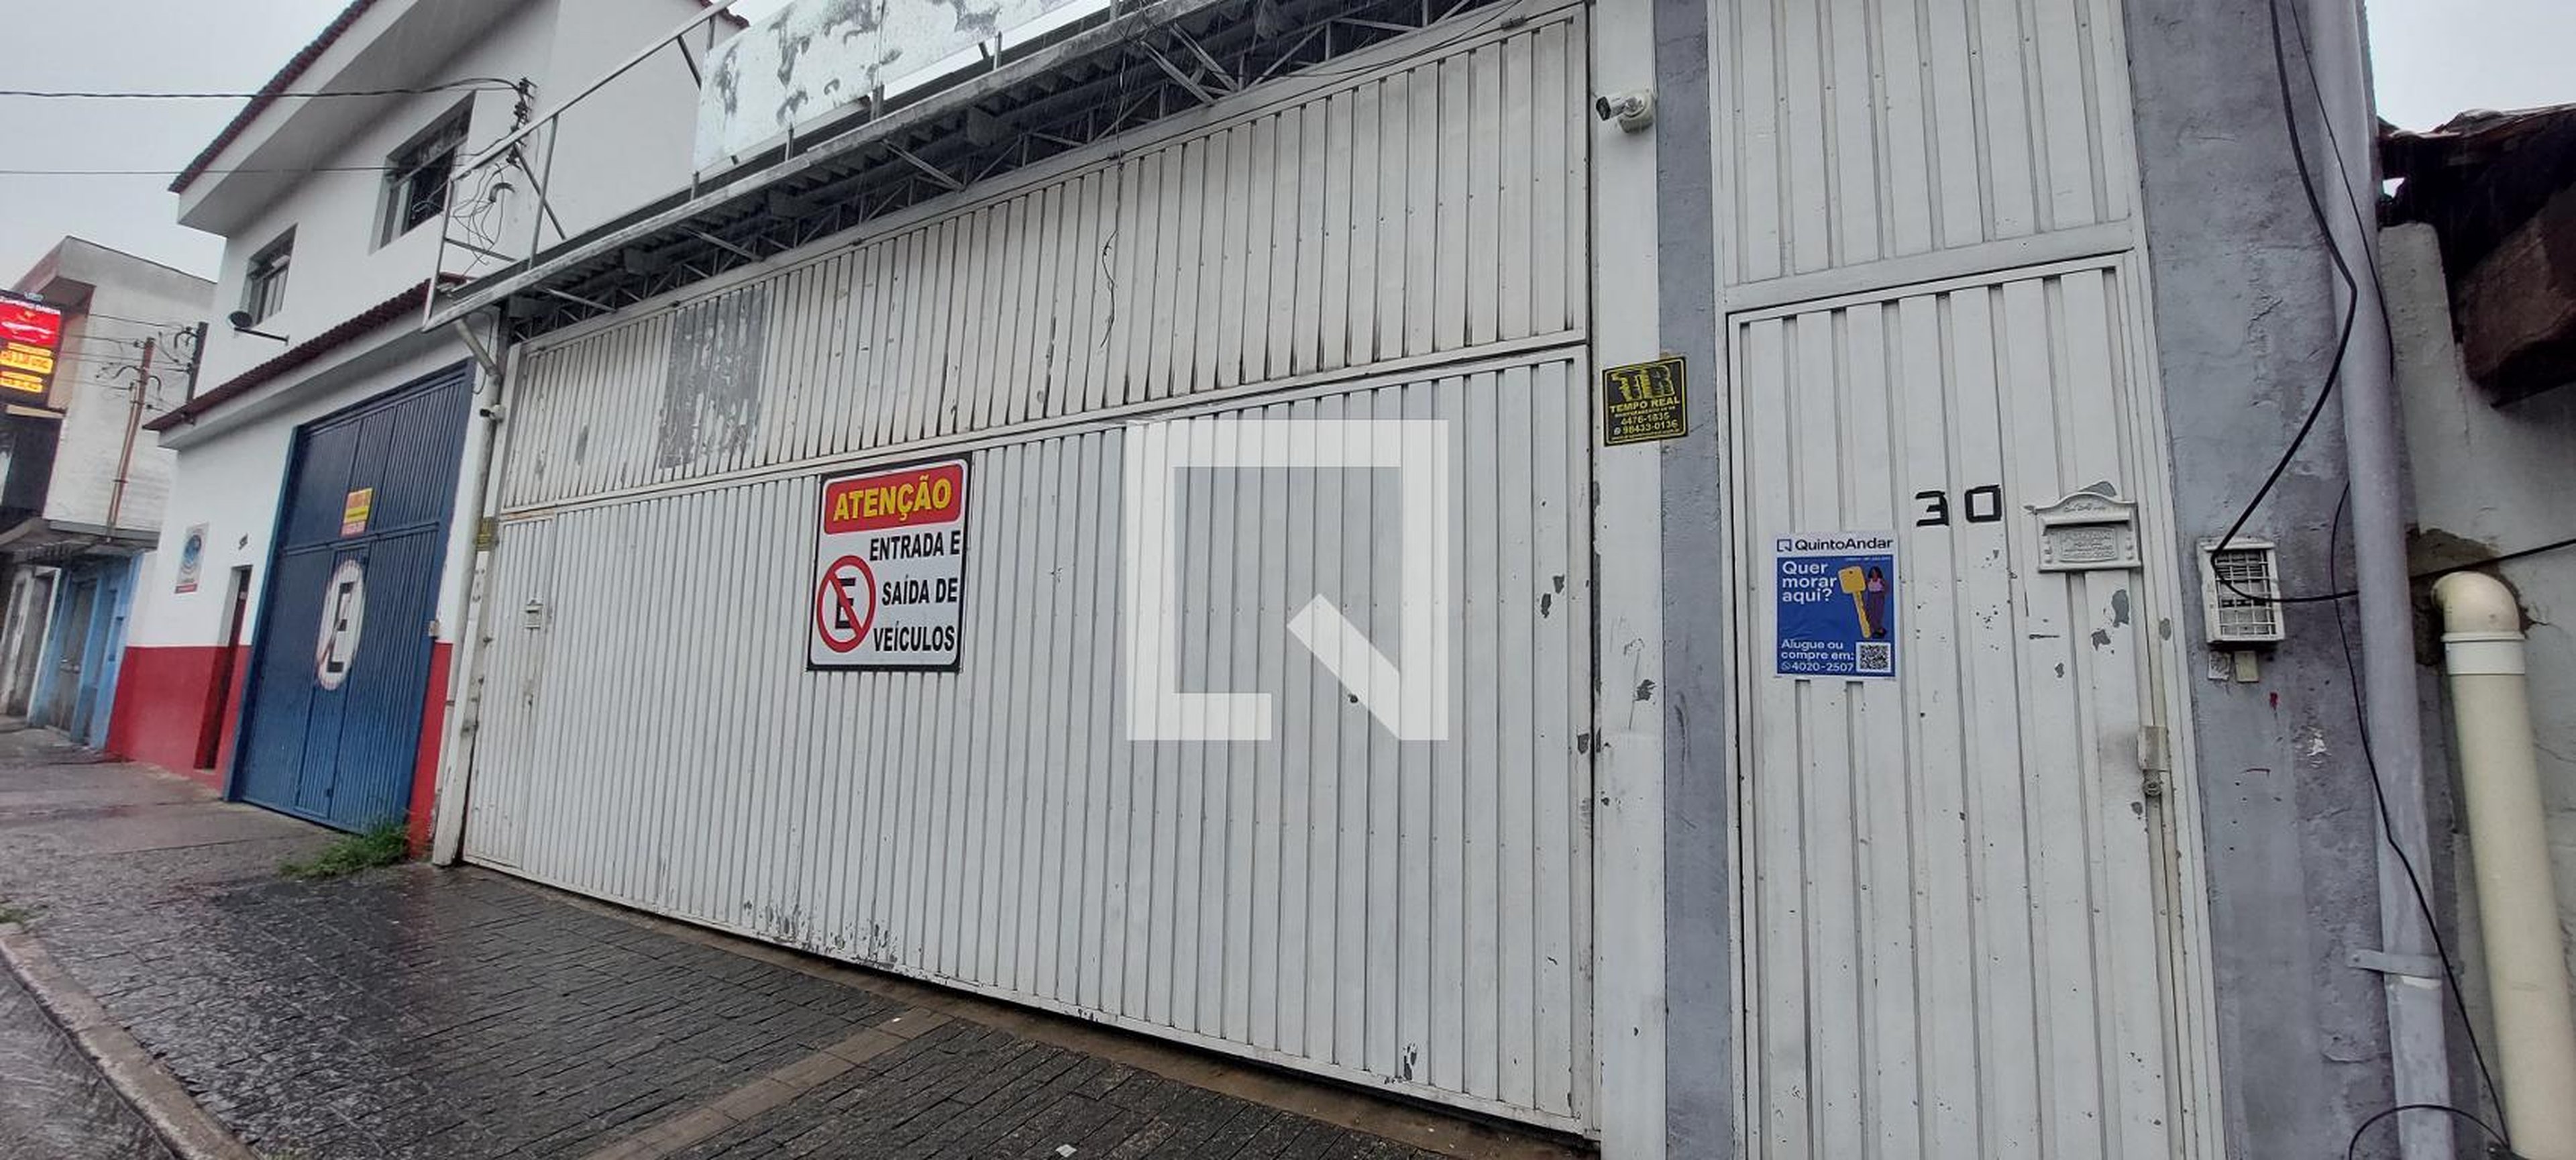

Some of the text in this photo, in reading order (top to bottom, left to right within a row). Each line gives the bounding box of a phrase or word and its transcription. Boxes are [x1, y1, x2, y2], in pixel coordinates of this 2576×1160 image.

[1610, 401, 1648, 413] TEMPO
[1651, 396, 1680, 407] REAL
[833, 474, 953, 521] ATENÇÃO
[1915, 484, 2002, 527] 30
[869, 530, 961, 561] ENTRADA E
[1794, 537, 1893, 551] QuintoAndar
[1782, 561, 1828, 575] Quer
[882, 574, 958, 605] SAÍDA DE
[1782, 576, 1837, 588] morar
[1782, 588, 1833, 604] aqui?
[873, 621, 955, 652] VEÍCULOS
[1781, 639, 1843, 651] Alugue ou
[1781, 651, 1854, 662] compre em:
[1792, 662, 1854, 672] 4020-2507
